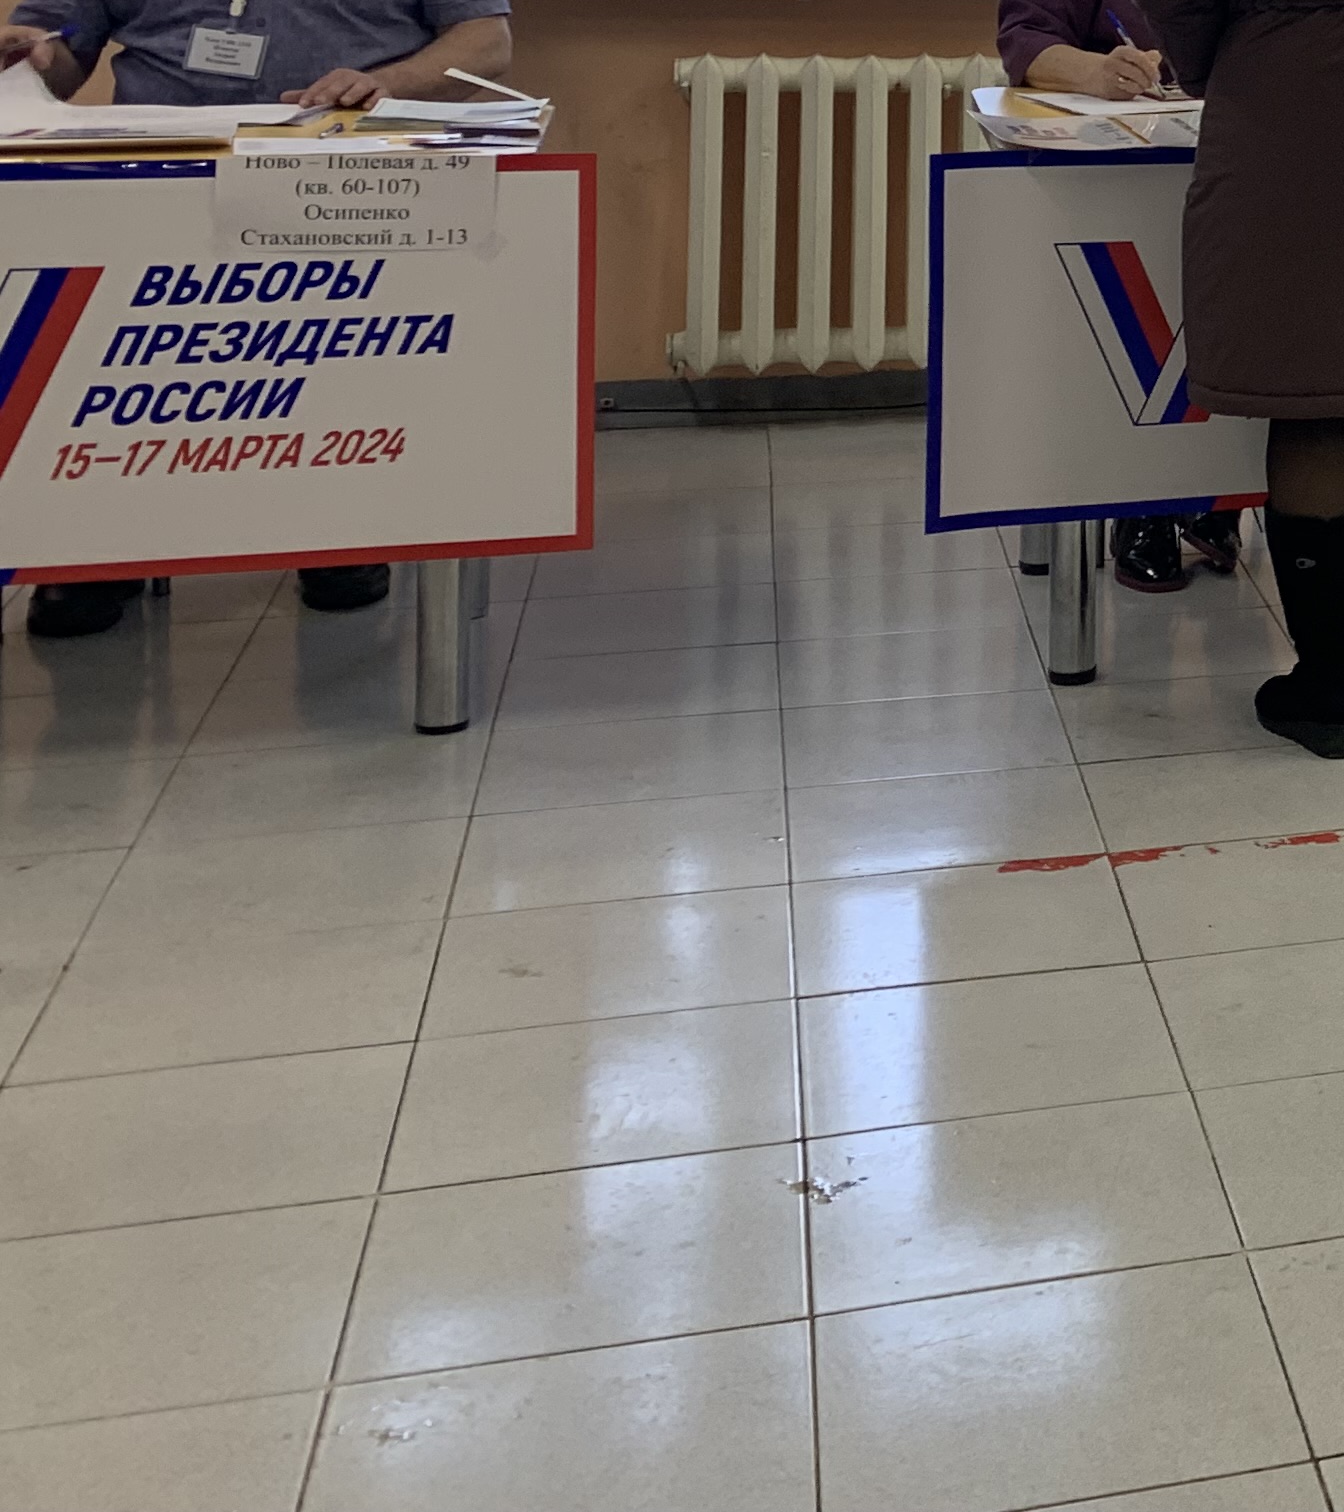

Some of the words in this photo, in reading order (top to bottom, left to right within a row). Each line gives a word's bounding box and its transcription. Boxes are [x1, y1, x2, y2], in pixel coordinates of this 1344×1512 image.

[420, 157, 438, 171] д.
[445, 155, 470, 170] 49
[295, 178, 333, 198] (кв.
[341, 178, 420, 197] 60-107)
[304, 204, 410, 220] Осипенко
[240, 228, 392, 246] Стахановский
[398, 232, 416, 247] д.
[427, 229, 468, 245] 1-13
[130, 259, 386, 308] ВЫБОРЫ
[101, 314, 455, 368] ПРЕЗИДЕНТА
[70, 377, 308, 428] РОССИИ
[49, 439, 167, 481] 15–17
[167, 432, 304, 476] МАРТА
[310, 427, 407, 468] 2024
